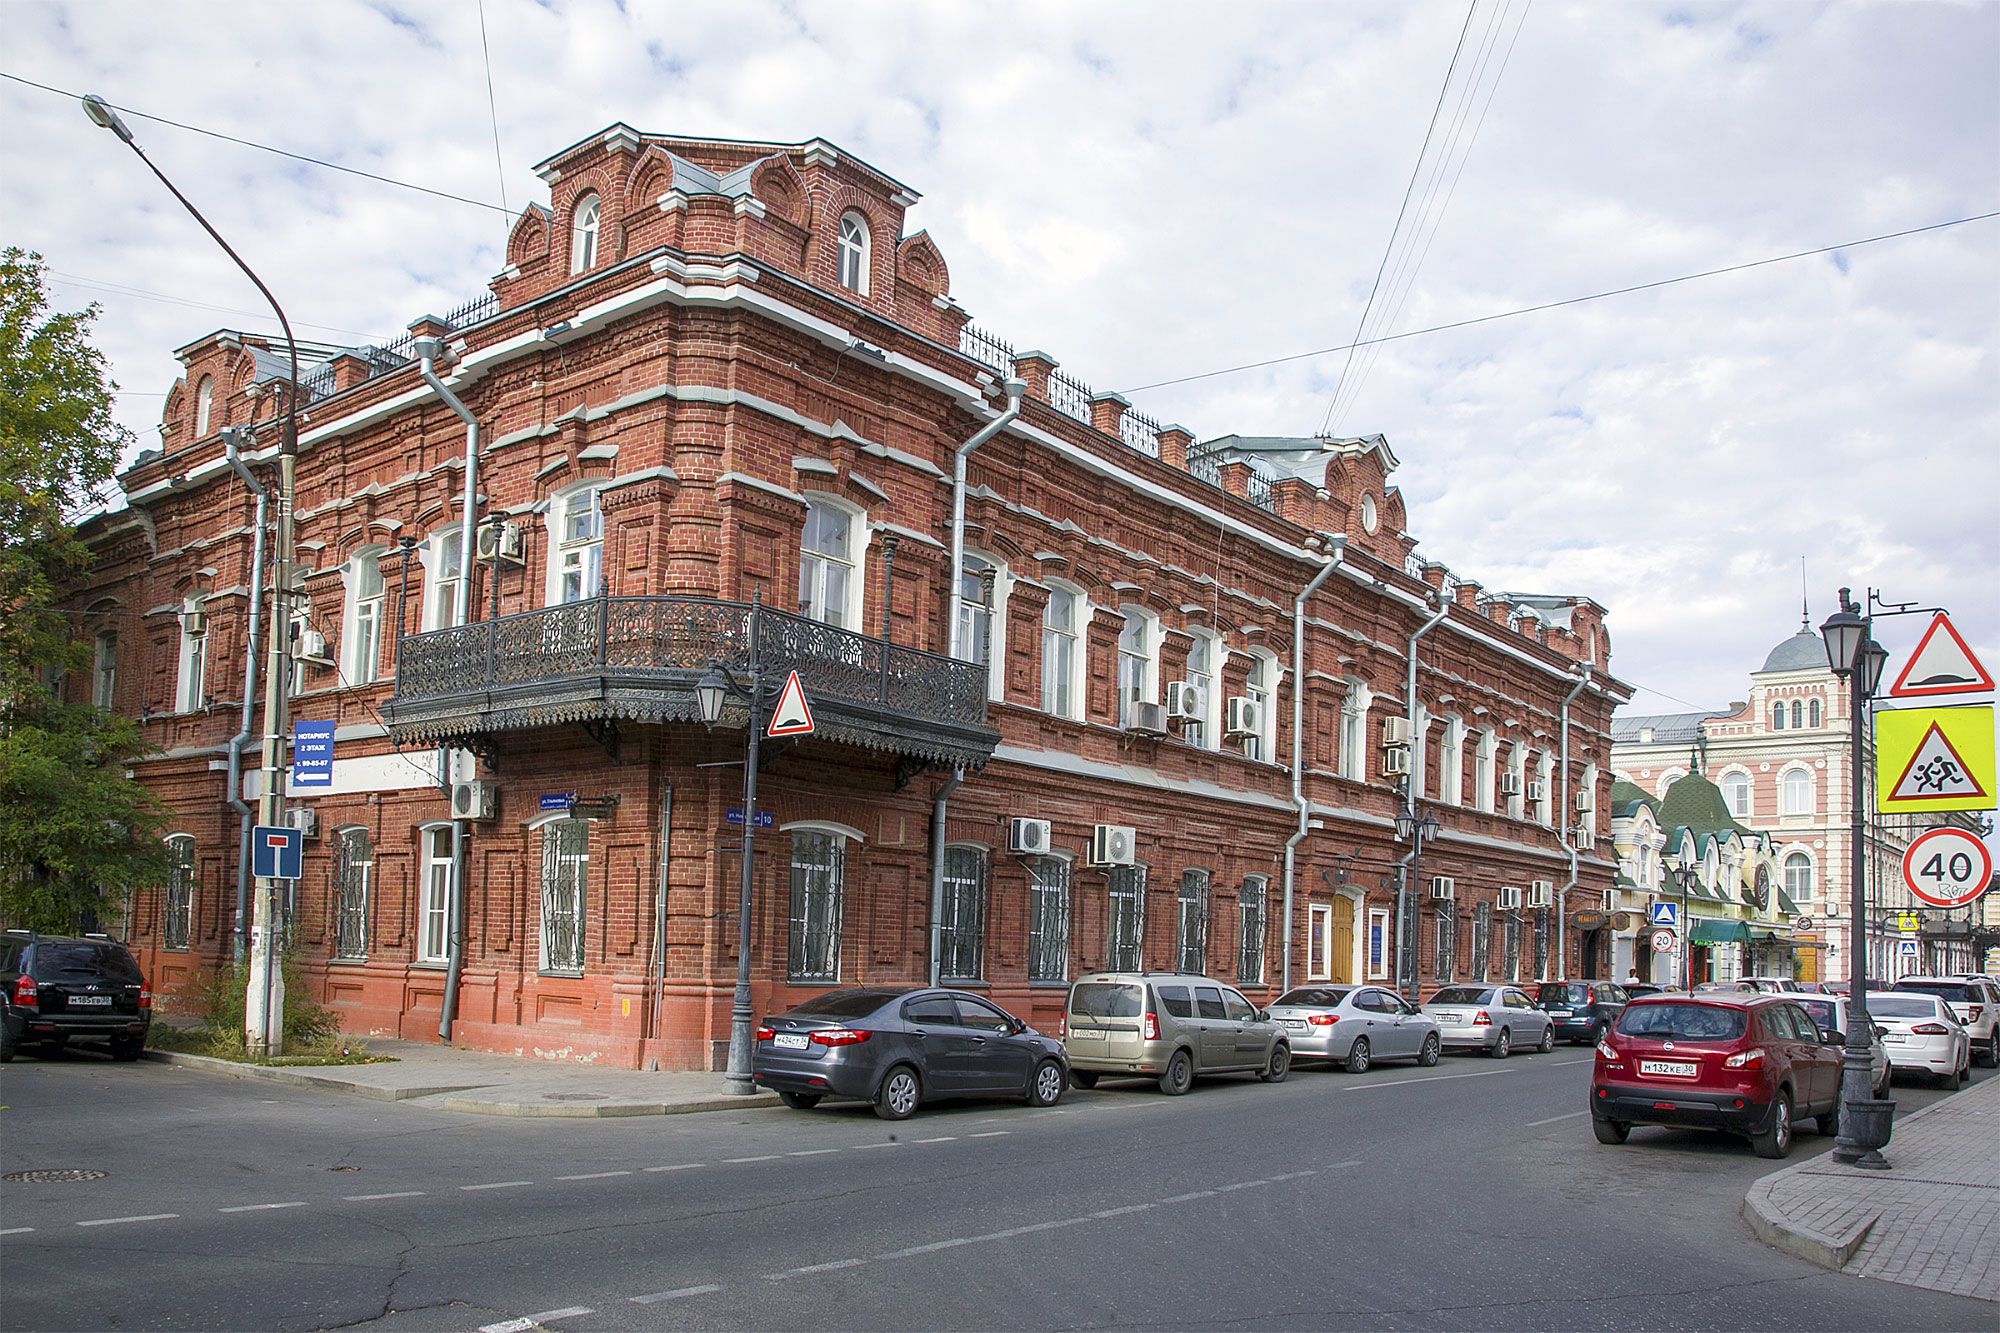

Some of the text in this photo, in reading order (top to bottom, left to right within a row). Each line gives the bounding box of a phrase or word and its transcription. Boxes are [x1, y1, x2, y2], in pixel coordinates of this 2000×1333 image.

[298, 732, 330, 740] НОТАРИУС
[764, 815, 772, 824] 10
[1920, 852, 1972, 882] 40
[1656, 936, 1669, 946] 20
[1644, 1063, 1681, 1074] М132КЕ
[1684, 1064, 1694, 1072] 30
